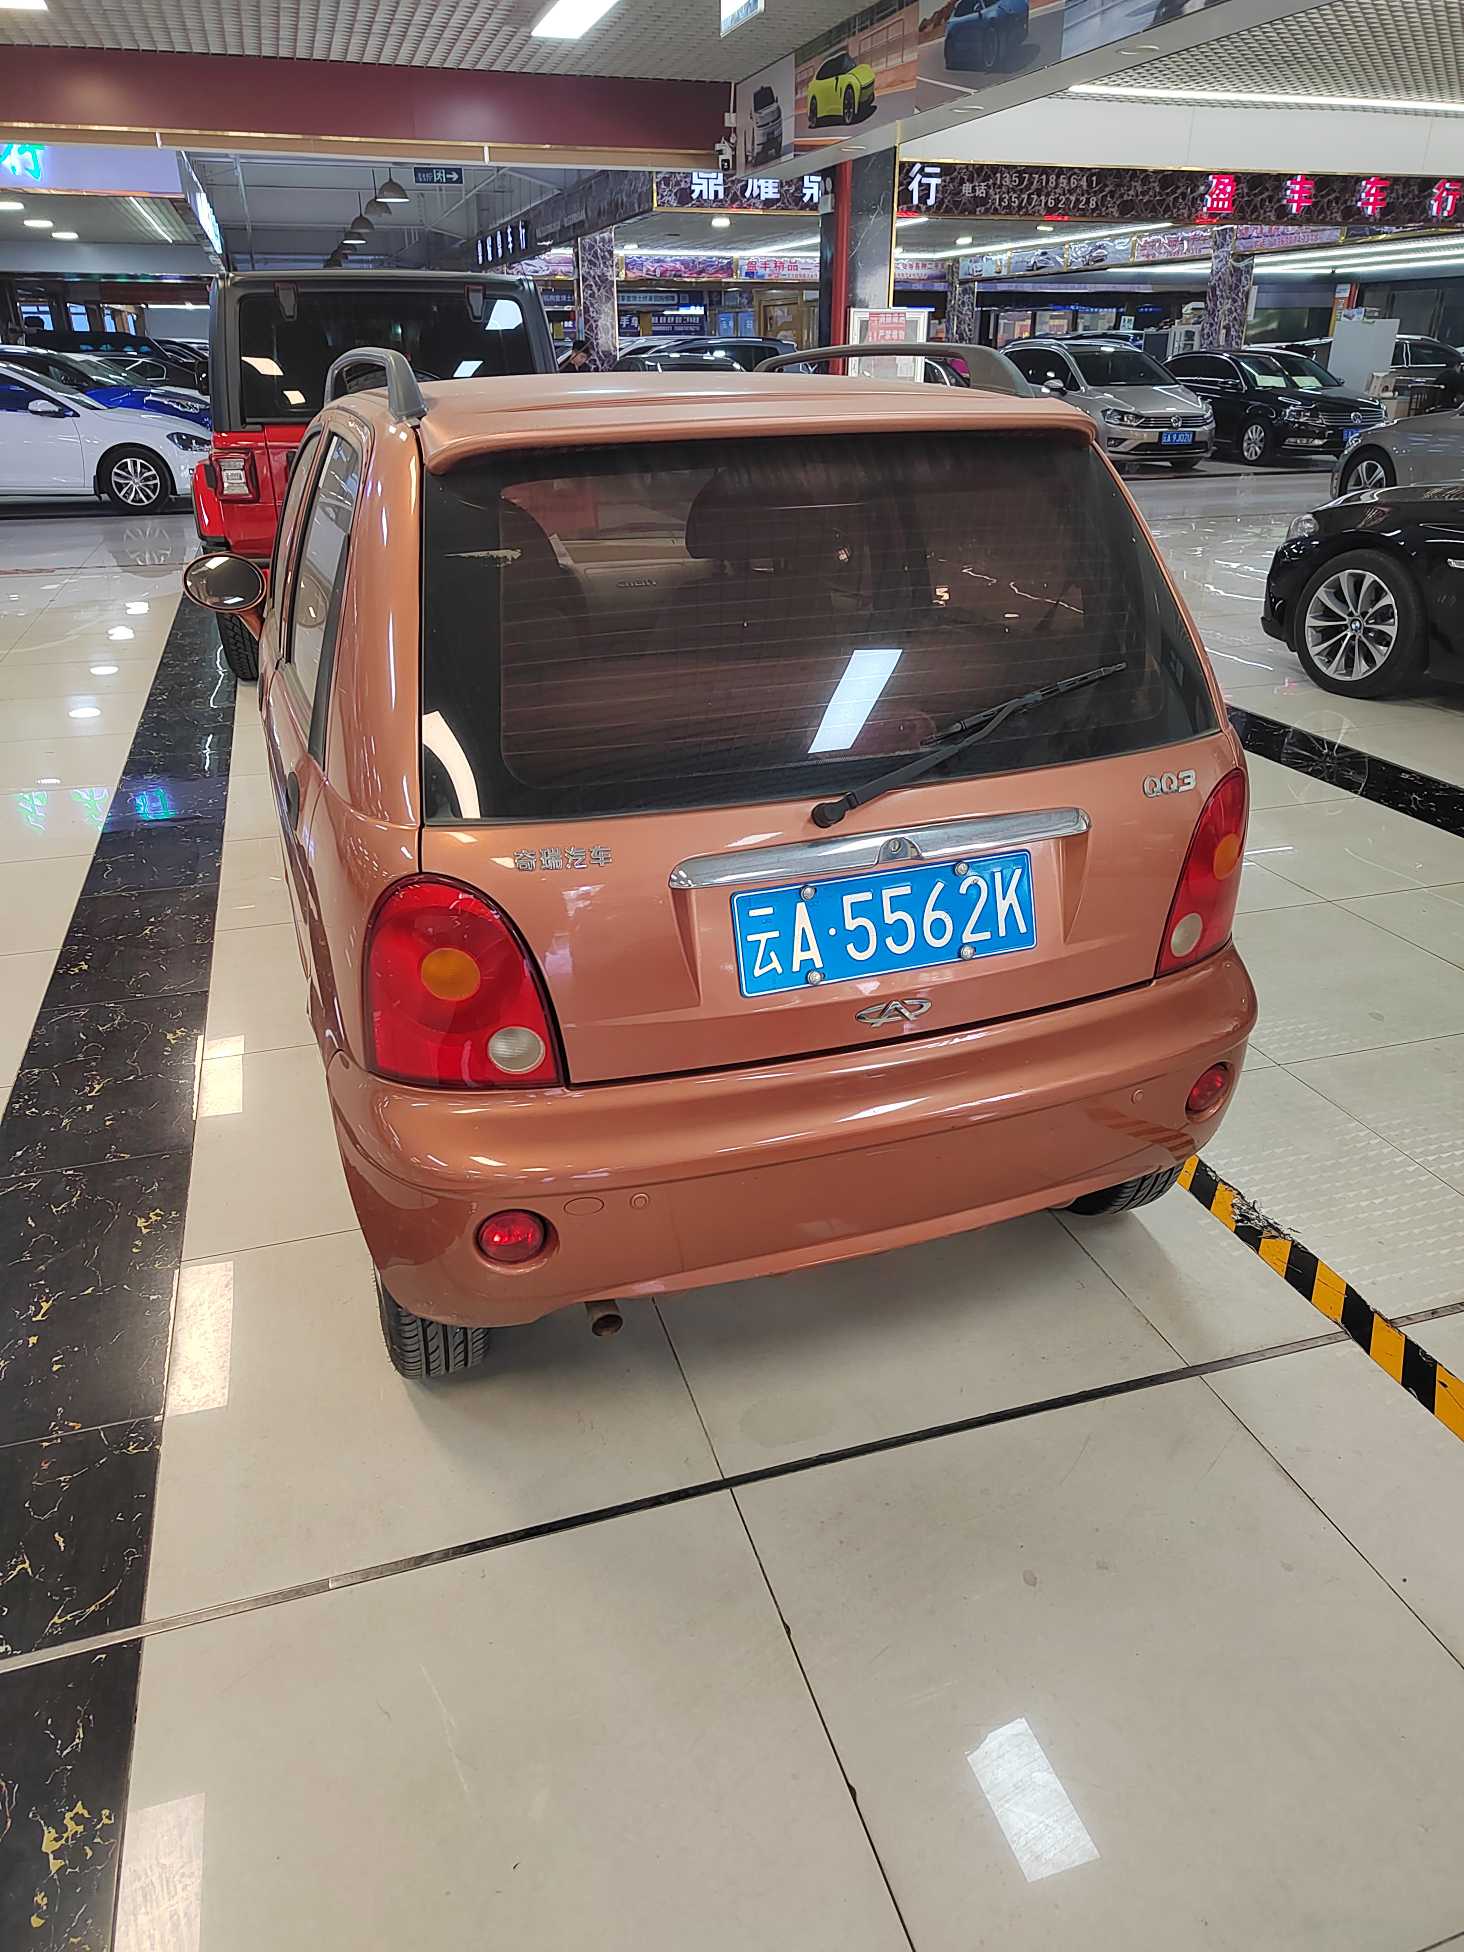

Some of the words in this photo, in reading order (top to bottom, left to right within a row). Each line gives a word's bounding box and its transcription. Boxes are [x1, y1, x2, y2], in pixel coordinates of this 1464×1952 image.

[908, 162, 942, 206] 行
[961, 182, 988, 198] 电话
[1203, 174, 1461, 217] 盈丰车行
[994, 194, 1097, 209] 13577162728
[1143, 769, 1197, 798] QQ3
[513, 845, 613, 871] 奇瑞汽车
